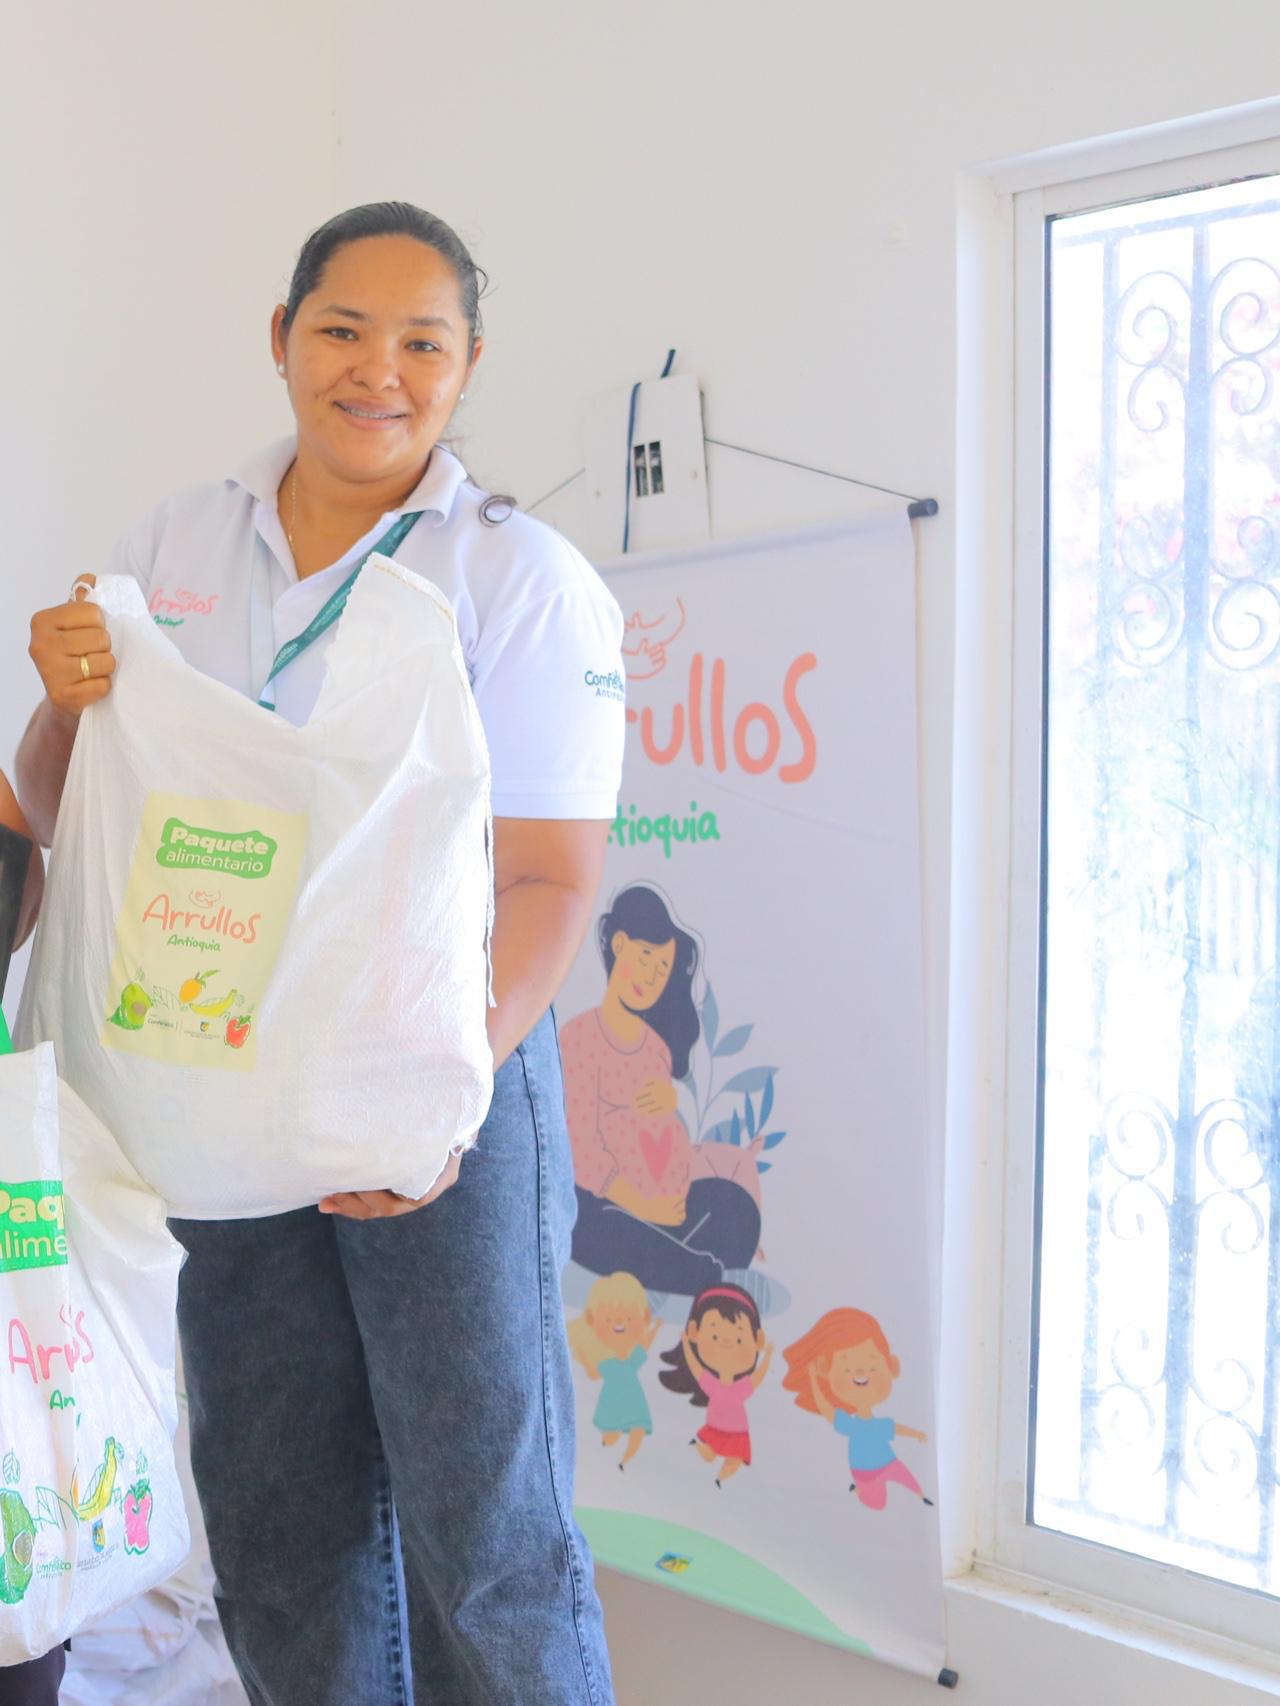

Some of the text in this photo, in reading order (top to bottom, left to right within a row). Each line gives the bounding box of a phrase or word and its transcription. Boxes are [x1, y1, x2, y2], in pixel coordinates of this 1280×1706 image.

[170, 826, 269, 855] Paquete
[608, 800, 721, 859] tioquia
[166, 847, 264, 873] alimentario
[167, 934, 221, 952] Antioquia
